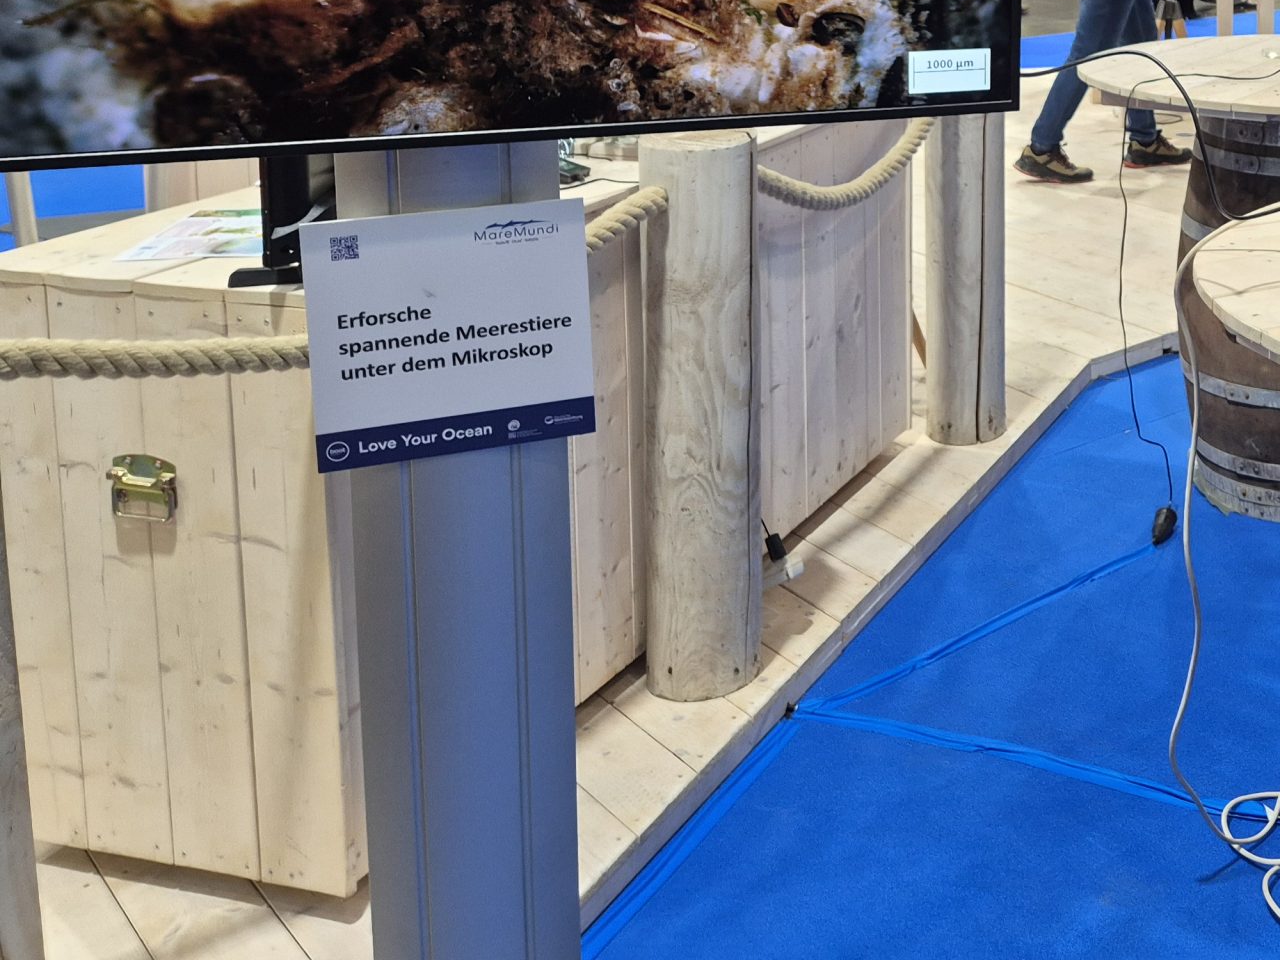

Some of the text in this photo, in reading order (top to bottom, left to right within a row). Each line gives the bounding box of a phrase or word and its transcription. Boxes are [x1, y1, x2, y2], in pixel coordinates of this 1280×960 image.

[927, 59, 974, 71] 1000 µm
[474, 224, 559, 242] MareMundi
[337, 305, 432, 330] Erforsche
[338, 314, 572, 358] spannende Meerestiere
[340, 340, 553, 381] unter dem Mikroskop
[358, 439, 397, 454] Love
[401, 433, 438, 447] Your
[441, 424, 493, 441] Ocean
